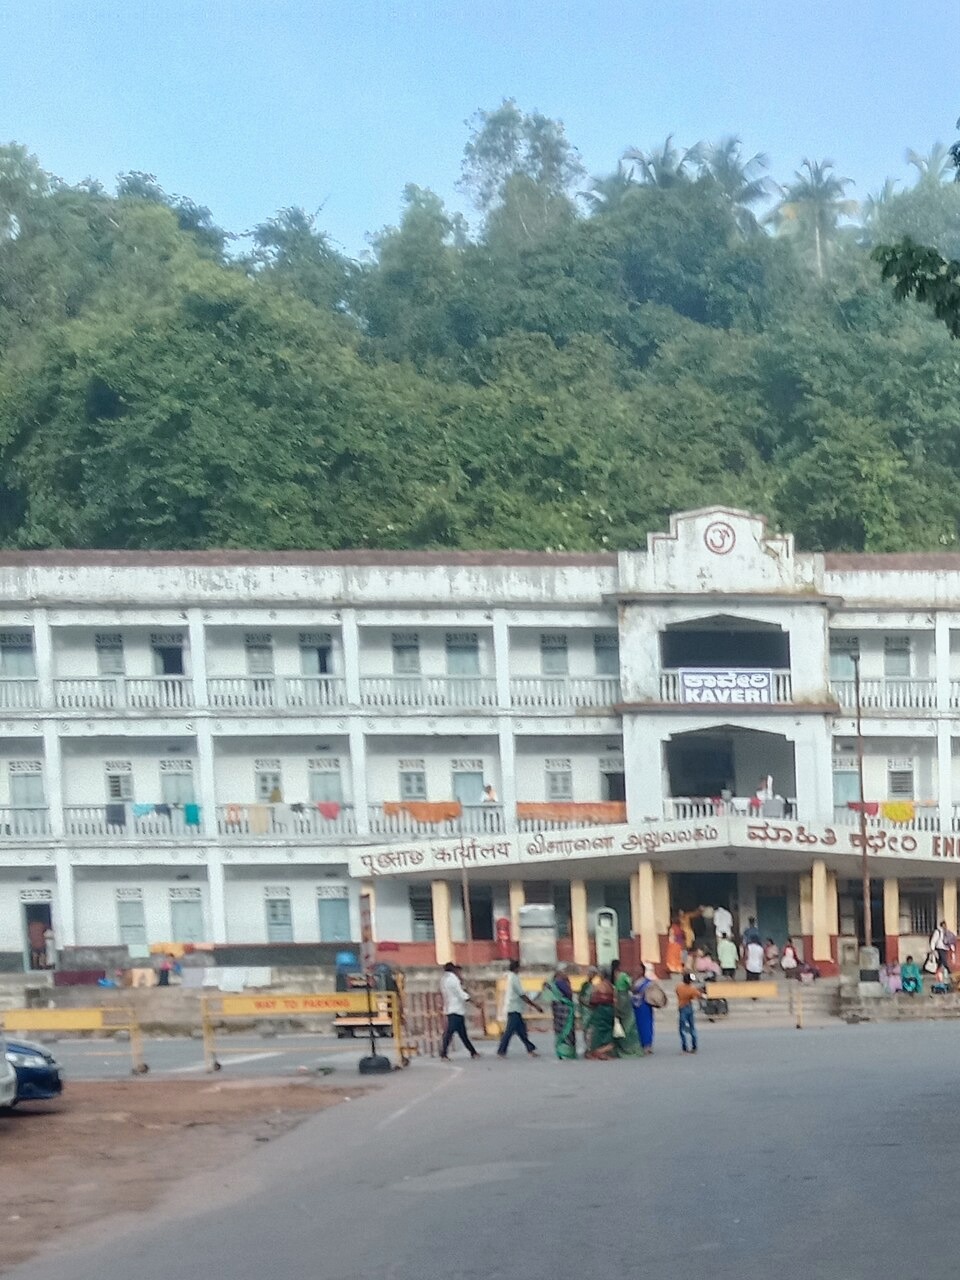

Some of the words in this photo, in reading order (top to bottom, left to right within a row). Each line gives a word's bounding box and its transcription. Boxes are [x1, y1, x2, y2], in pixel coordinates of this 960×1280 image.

[685, 688, 768, 704] KAVERI
[747, 821, 838, 846] ಮಾಹಿತಿ
[283, 999, 297, 1009] TO
